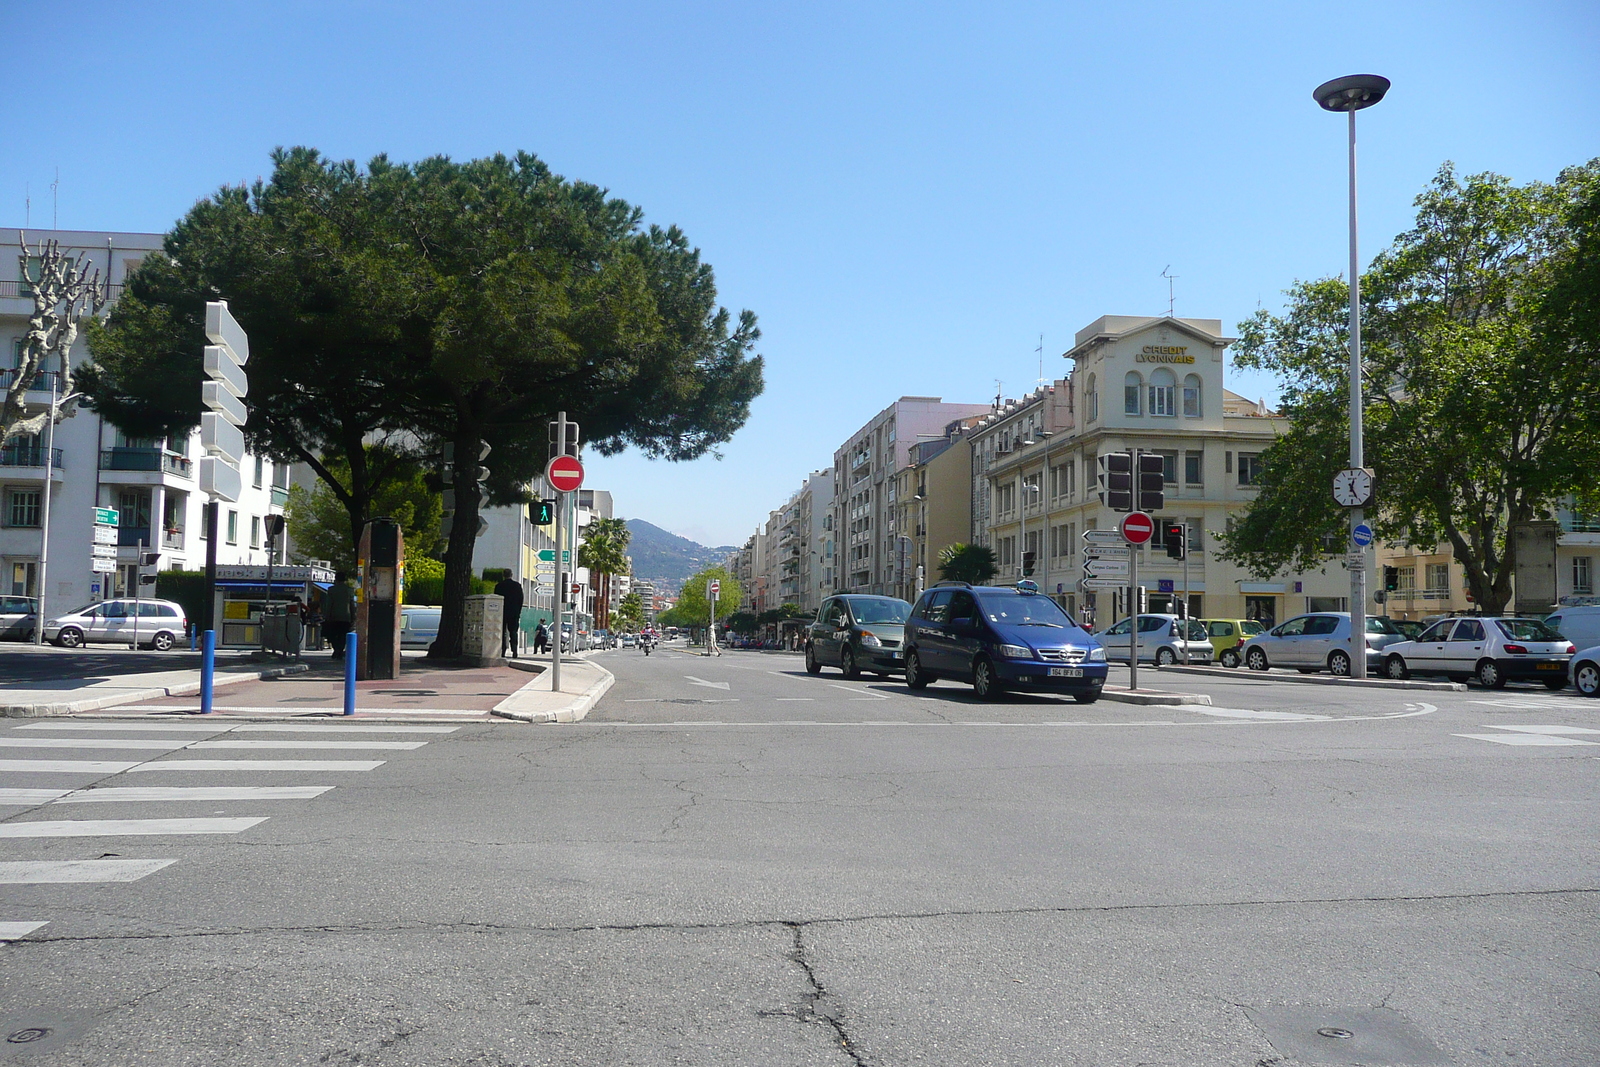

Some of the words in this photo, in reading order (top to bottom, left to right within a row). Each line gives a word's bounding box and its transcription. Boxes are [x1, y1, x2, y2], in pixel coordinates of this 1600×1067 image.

[1143, 345, 1187, 354] CREDIT
[1136, 354, 1195, 364] LYONNAIS
[217, 568, 253, 577] nack
[259, 568, 310, 579] gacier
